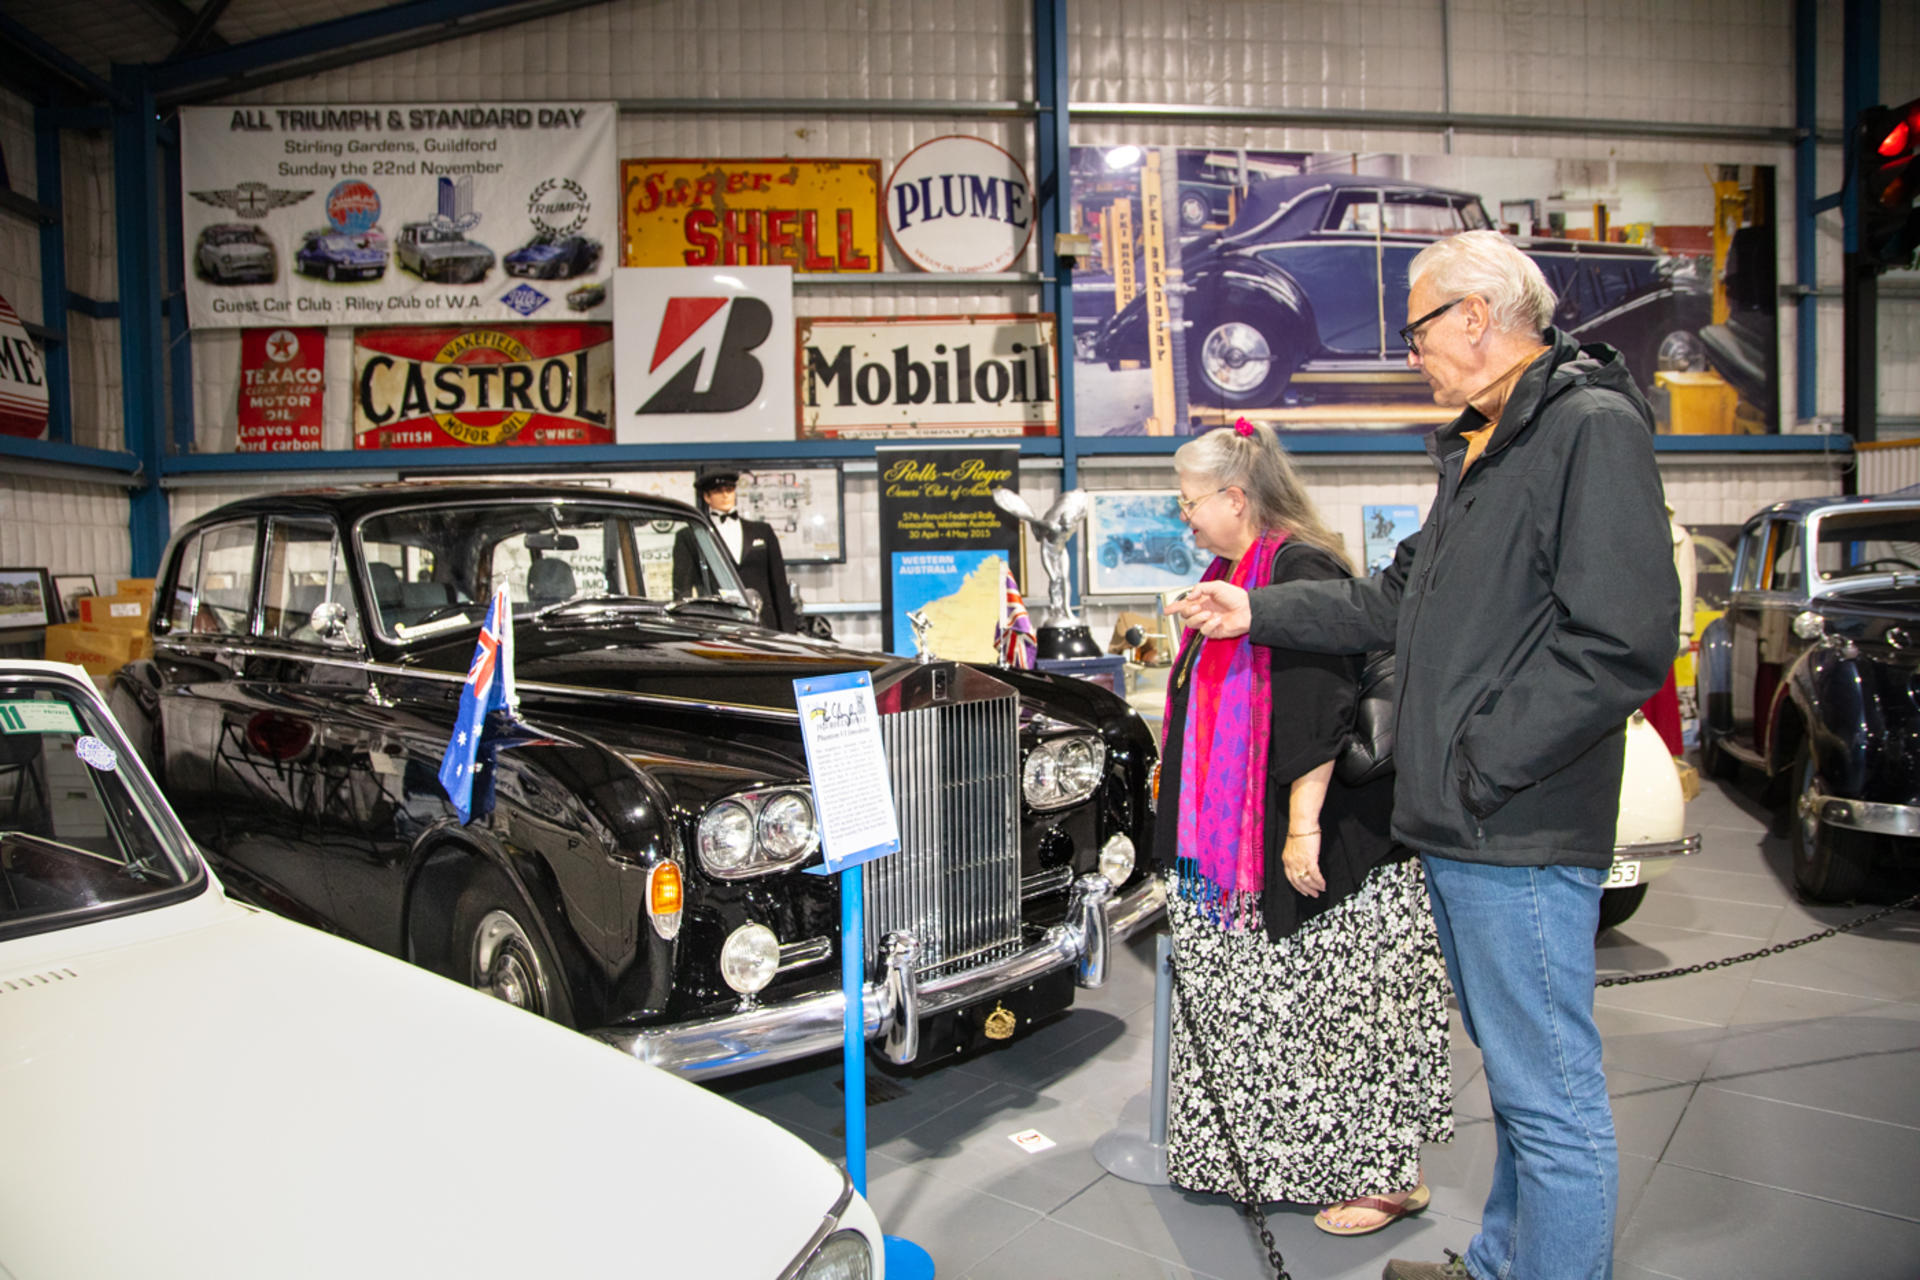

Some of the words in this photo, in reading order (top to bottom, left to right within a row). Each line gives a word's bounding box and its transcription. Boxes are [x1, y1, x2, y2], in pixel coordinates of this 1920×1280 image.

[231, 110, 272, 131] ALL
[276, 109, 381, 131] TRIUMPH
[387, 110, 404, 130] &
[409, 108, 534, 130] STANDARD
[538, 108, 586, 129] DAY
[284, 139, 342, 157] Stirling
[347, 139, 420, 154] Gardens,
[424, 137, 497, 152] Guildford
[278, 161, 336, 178] Sunday
[341, 161, 368, 175] the
[372, 160, 416, 175] 22nd
[421, 160, 503, 175] November
[527, 202, 591, 215] TRIUMPH
[893, 173, 1028, 232] PLUME
[684, 208, 870, 270] SHELL
[212, 298, 260, 313] Guest
[263, 297, 291, 312] Car
[297, 297, 332, 311] Club
[345, 296, 384, 312] Riley
[387, 295, 421, 310] Club
[425, 294, 441, 308] of
[443, 333, 521, 360] WAKEFIELD
[245, 368, 322, 385] TEXACO
[804, 343, 1055, 408] Mobiloil
[361, 351, 607, 424] CASTROL
[250, 396, 311, 409] MOTOR
[240, 425, 293, 438] Leaves
[300, 425, 320, 437] no
[444, 418, 489, 442] MOTOR
[502, 416, 526, 434] OIL
[272, 438, 320, 451] carbon
[924, 482, 949, 498] Club
[950, 484, 962, 501] of
[921, 512, 947, 521] Annual
[949, 511, 977, 521] Federal
[937, 520, 967, 529] Western
[969, 519, 1002, 528] Australia
[920, 530, 940, 540] April
[953, 530, 969, 540] May
[901, 556, 954, 565] WESTERN
[899, 565, 957, 575] AUSTRALIA
[1611, 864, 1637, 883] 53
